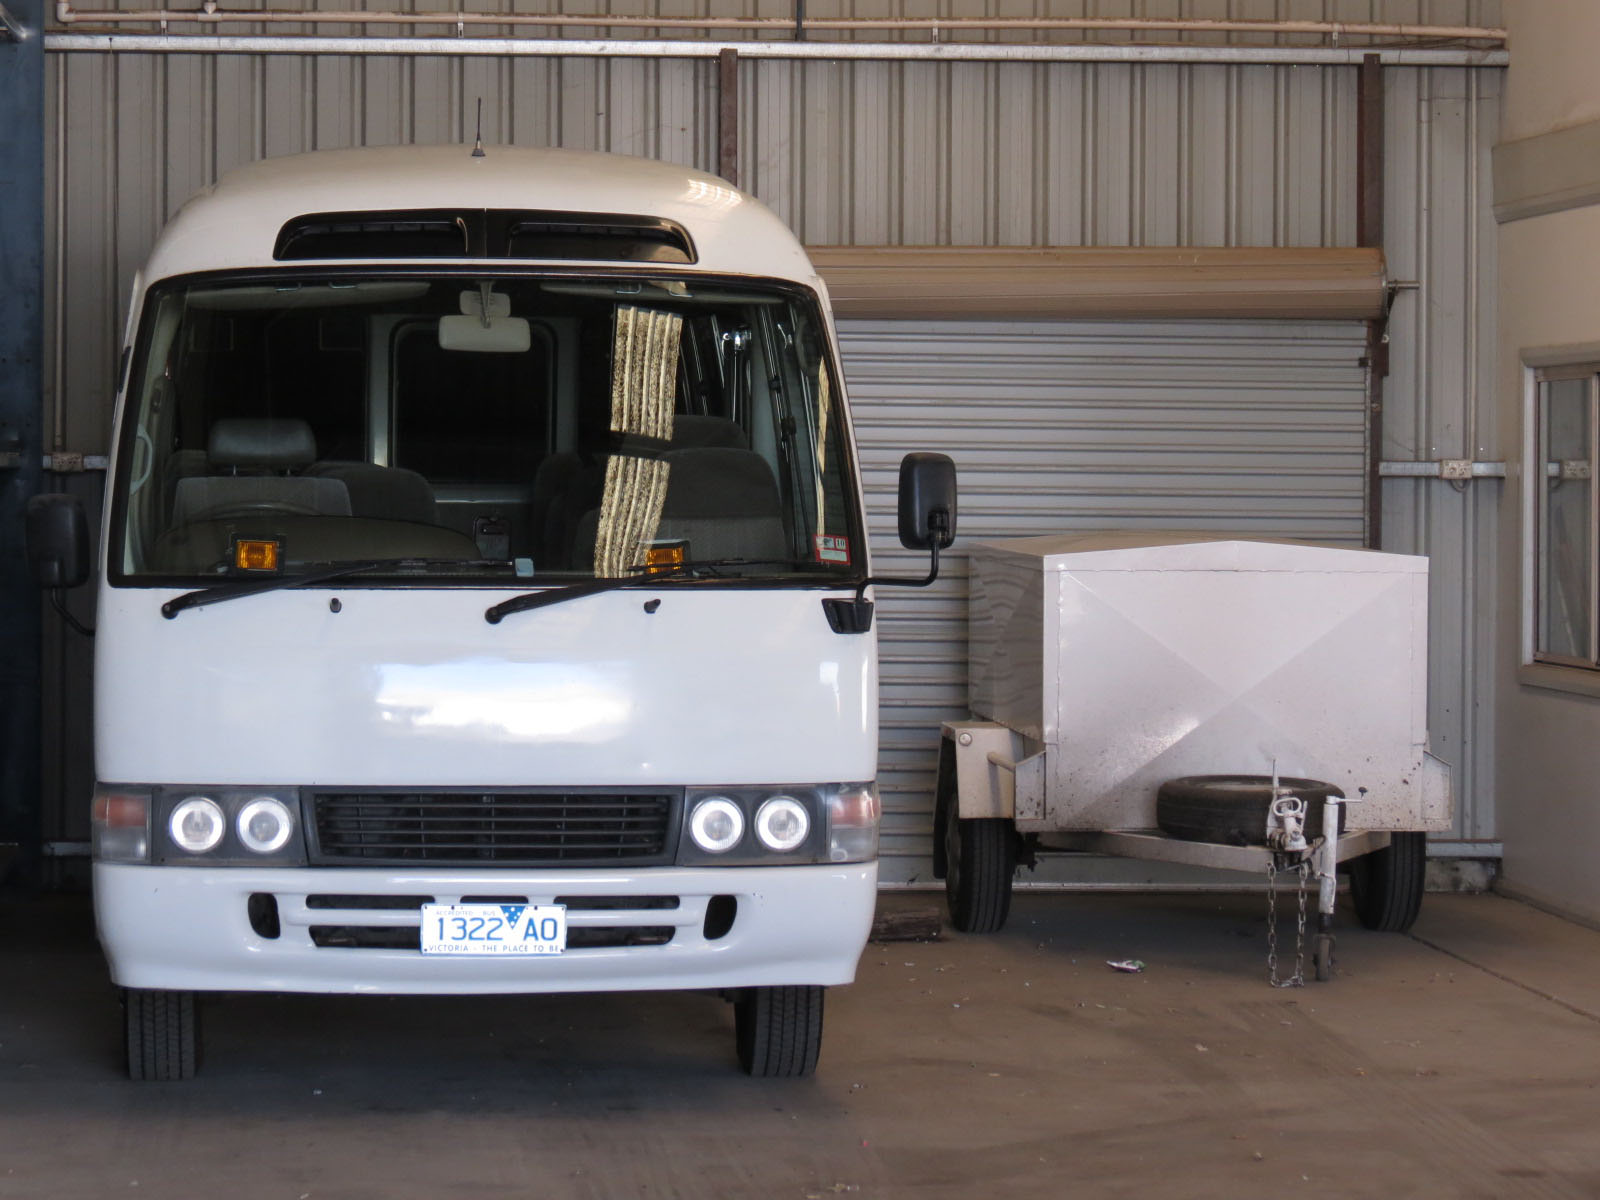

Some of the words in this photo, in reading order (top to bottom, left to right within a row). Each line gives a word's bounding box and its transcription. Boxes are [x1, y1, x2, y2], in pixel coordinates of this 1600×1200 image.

[438, 917, 504, 941] 1322
[428, 944, 469, 952] VICTORIA
[482, 944, 498, 952] THE
[503, 944, 528, 952] PLACE
[533, 944, 544, 952] TO
[549, 944, 559, 952] BE
